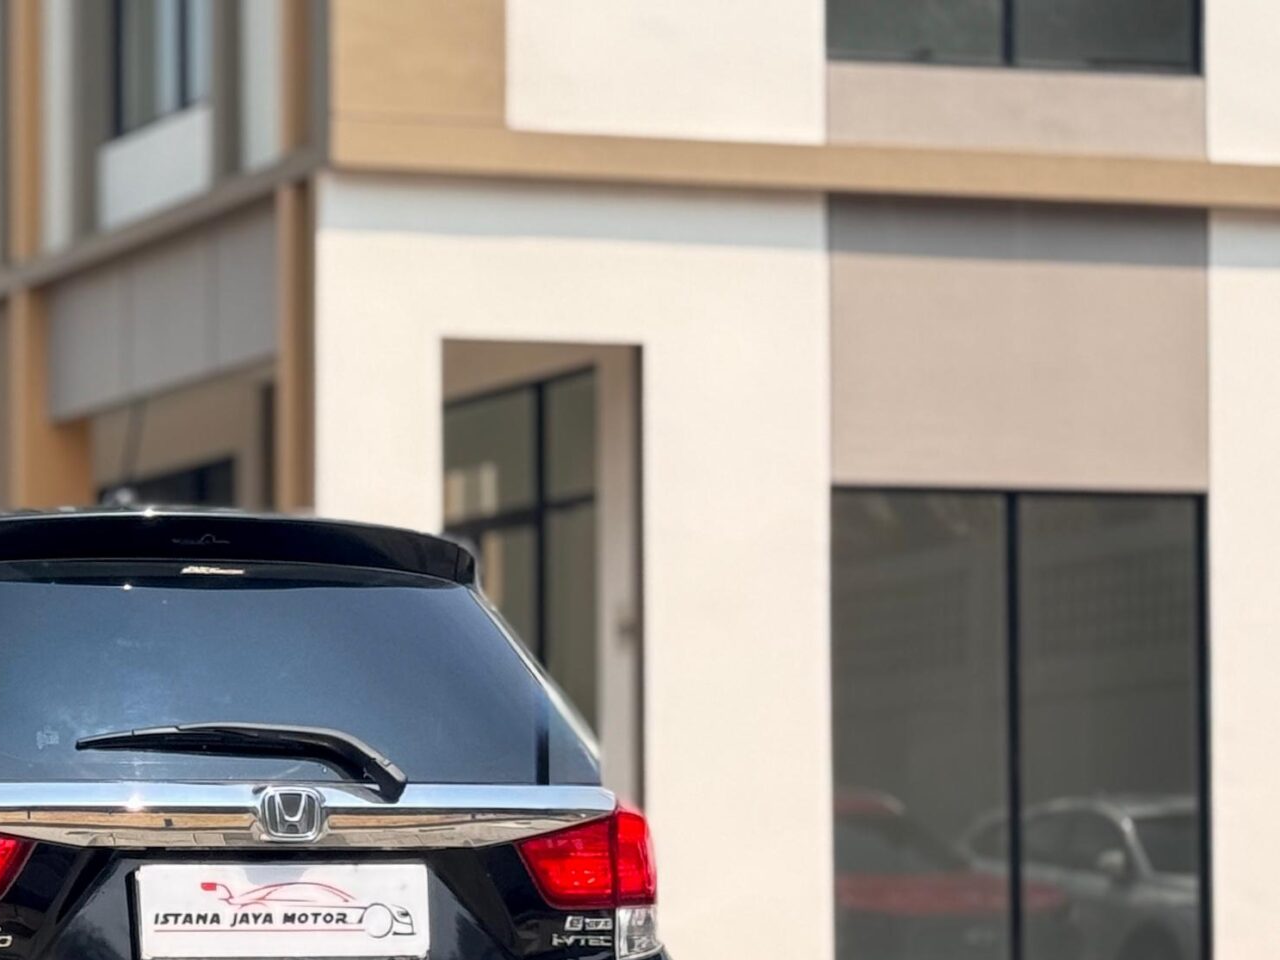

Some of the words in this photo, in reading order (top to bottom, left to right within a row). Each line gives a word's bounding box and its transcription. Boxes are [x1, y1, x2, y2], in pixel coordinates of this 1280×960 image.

[154, 912, 221, 925] ISTANA
[230, 912, 274, 928] JAYA
[282, 912, 348, 925] MOTOR
